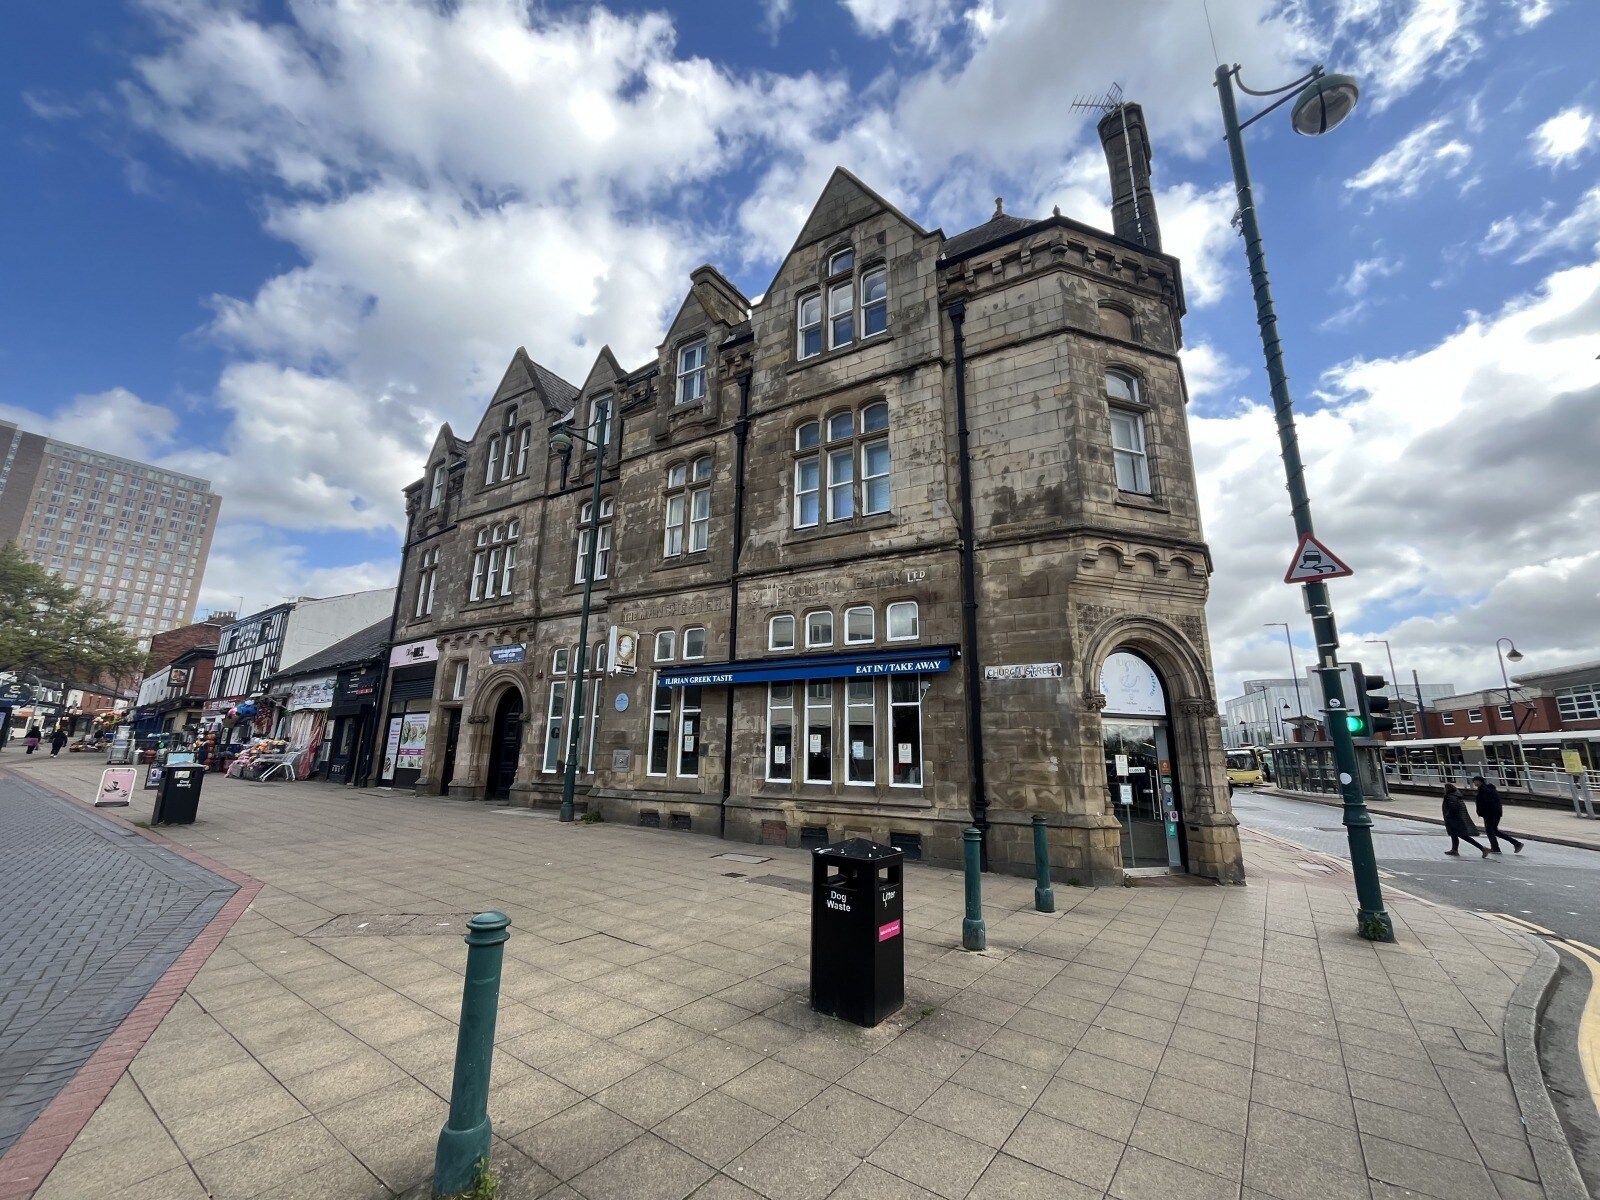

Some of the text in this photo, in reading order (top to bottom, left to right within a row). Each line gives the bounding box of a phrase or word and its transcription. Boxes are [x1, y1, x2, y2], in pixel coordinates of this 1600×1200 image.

[623, 612, 637, 622] THE
[776, 578, 842, 600] COUNTY
[907, 570, 926, 583] LTD
[665, 677, 689, 685] ILIRIAN
[689, 675, 711, 683] GREEK
[712, 674, 733, 682] TASTE
[855, 665, 872, 673] EAT
[874, 664, 884, 672] IN
[889, 662, 913, 671] TAKE
[915, 660, 941, 670] AWAY
[987, 666, 1021, 676] CHURC
[830, 890, 847, 903] Dog
[826, 899, 851, 912] Waste
